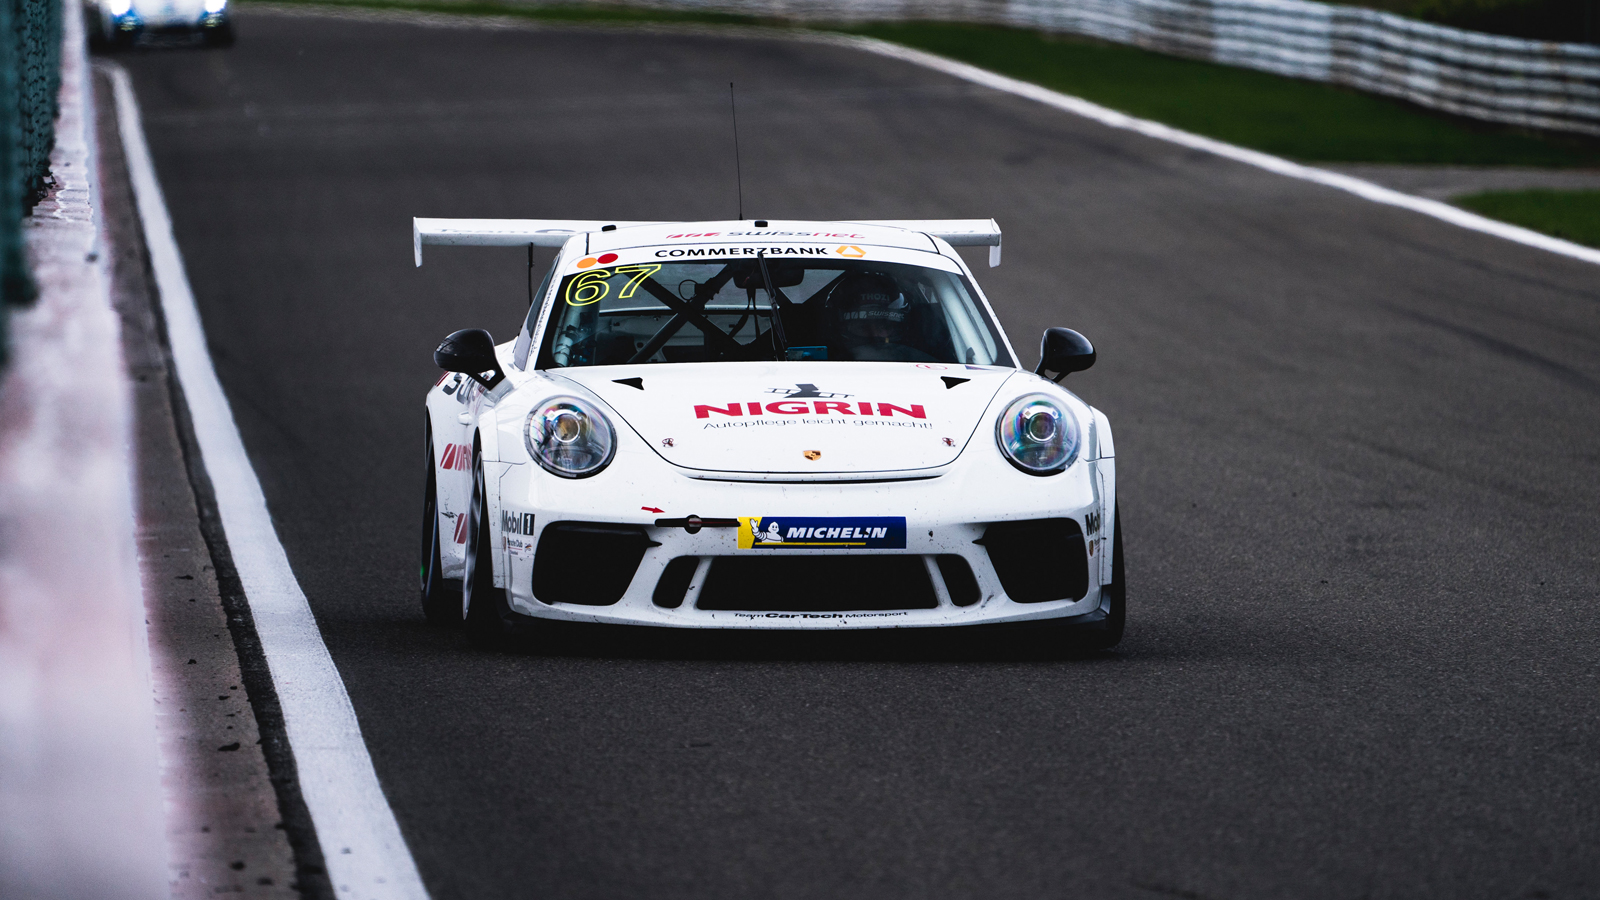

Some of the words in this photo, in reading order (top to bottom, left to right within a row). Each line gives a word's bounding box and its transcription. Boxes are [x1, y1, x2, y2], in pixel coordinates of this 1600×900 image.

[727, 230, 866, 239] swissnet
[655, 246, 829, 258] COMMERZBANK
[565, 264, 662, 306] 67
[693, 400, 927, 419] NIGRIN
[703, 418, 797, 430] Autopflege
[802, 417, 848, 425] leicht
[852, 418, 934, 430] gemacht!
[502, 510, 522, 534] Mobil
[786, 527, 888, 538] MICHELIN
